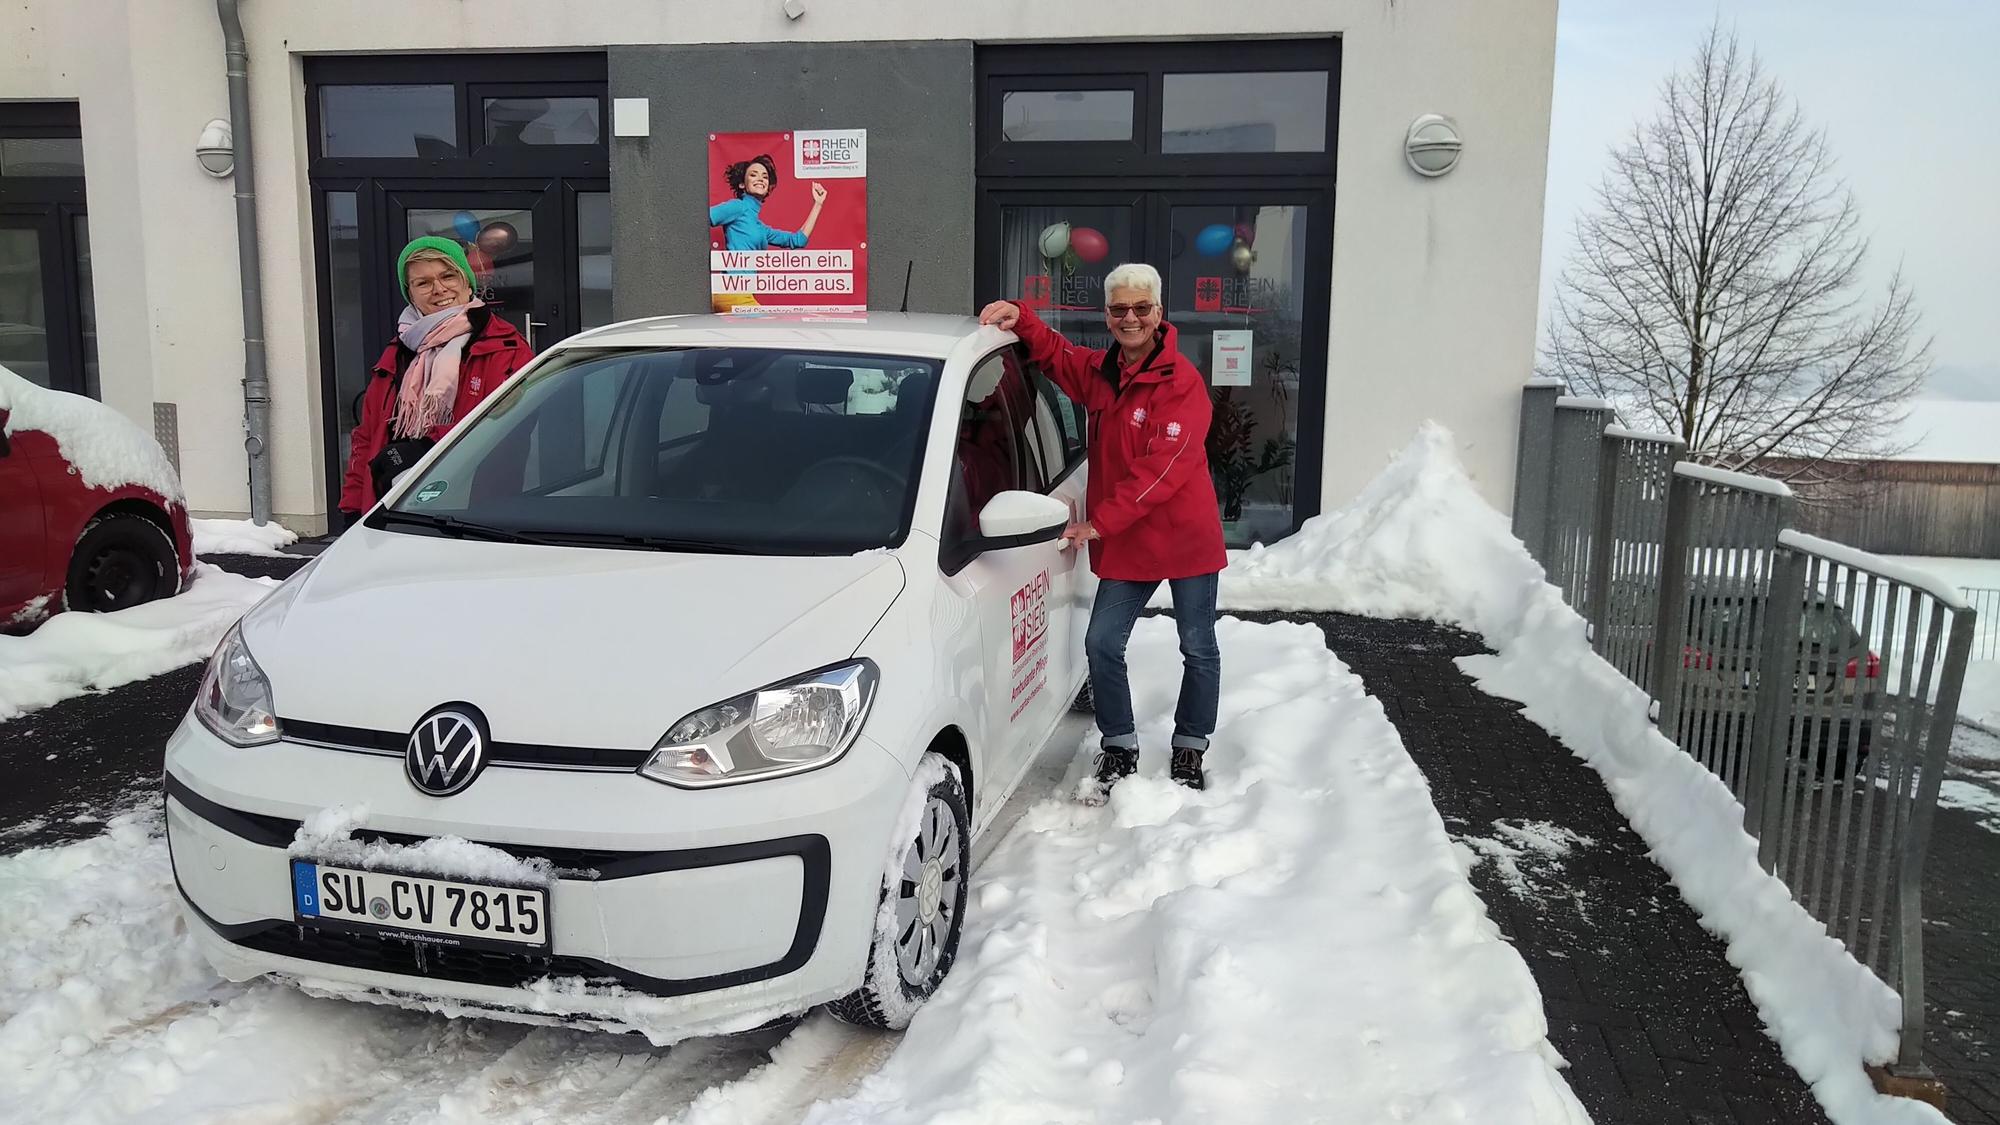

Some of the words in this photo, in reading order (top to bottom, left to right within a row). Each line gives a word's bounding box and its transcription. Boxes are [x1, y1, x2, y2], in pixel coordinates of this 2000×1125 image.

[821, 138, 859, 149] RHEIN
[822, 150, 851, 161] SIEG
[721, 252, 750, 268] Wir
[755, 252, 811, 268] stellen
[817, 252, 848, 268] ein.
[721, 275, 750, 291] Wir
[756, 275, 808, 291] bilden
[814, 278, 850, 291] aus.
[1062, 276, 1101, 289] HEIN
[1062, 290, 1089, 304] IEG
[1025, 567, 1050, 609] RHEIN
[1026, 601, 1046, 640] SIEG
[304, 894, 313, 906] D
[322, 872, 367, 916] SU
[391, 881, 435, 924] CV
[445, 887, 539, 936] 7815
